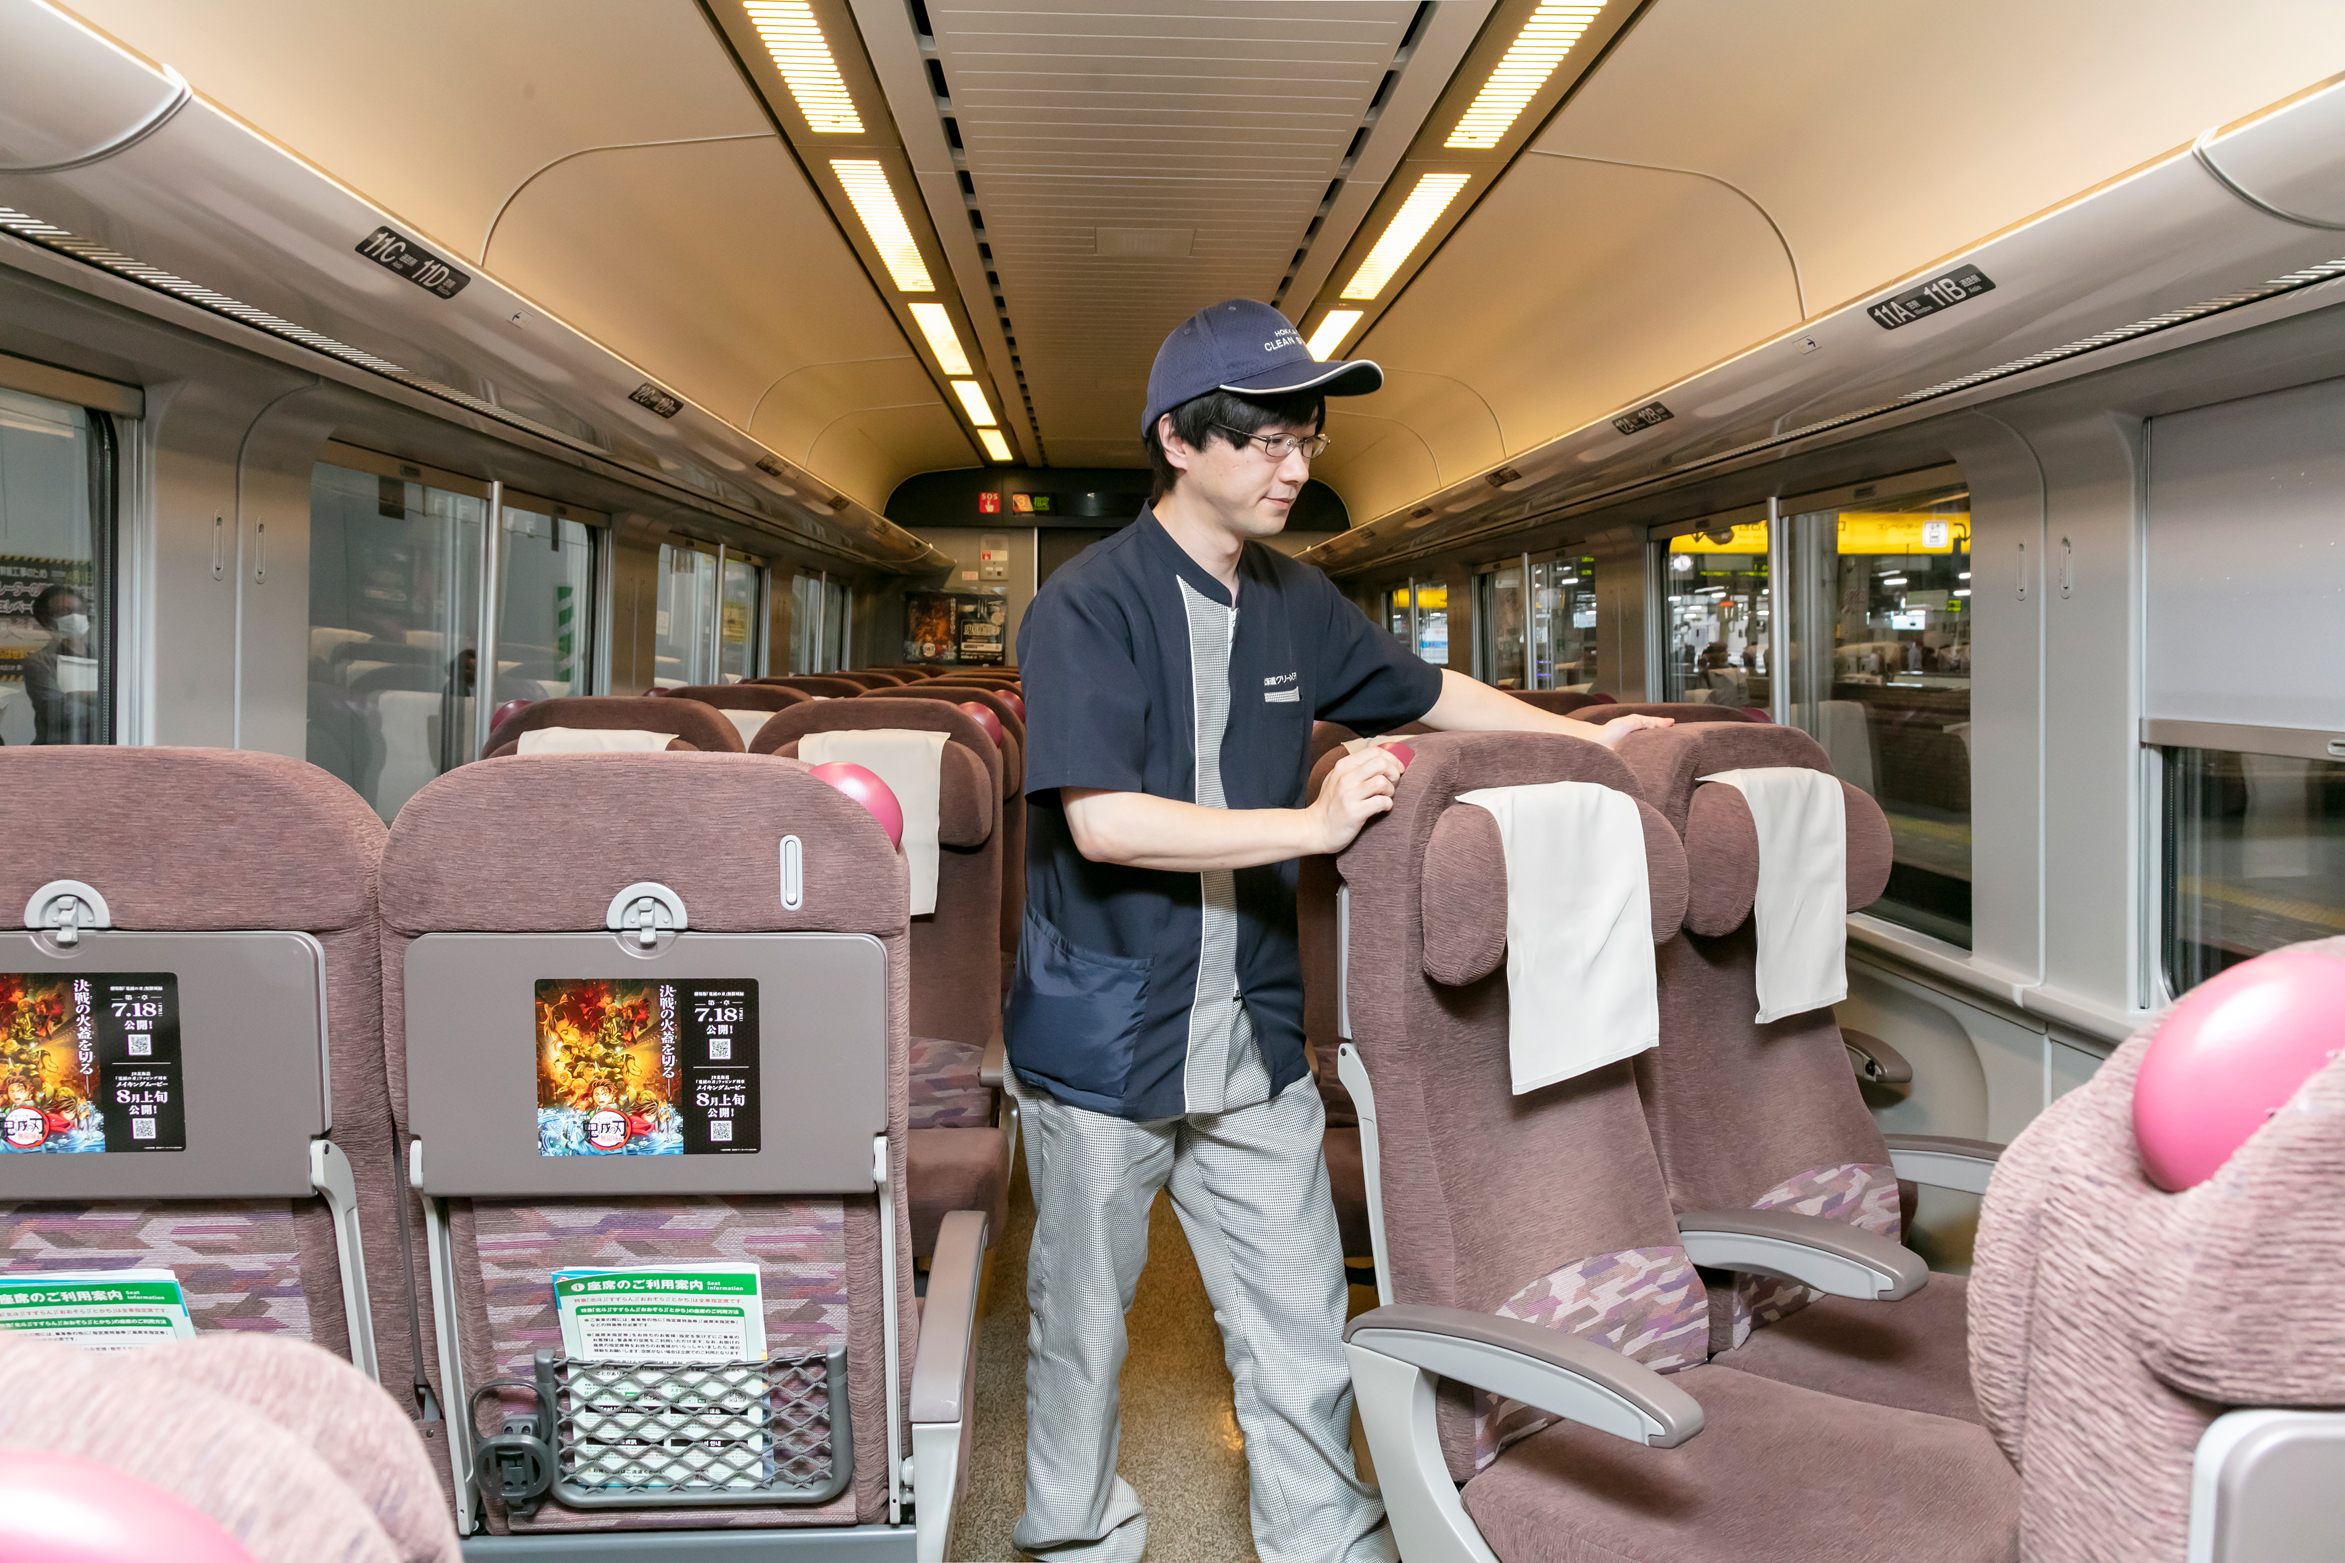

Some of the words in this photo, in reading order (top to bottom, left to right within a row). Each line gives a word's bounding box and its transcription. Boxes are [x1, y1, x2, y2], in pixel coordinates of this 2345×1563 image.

[363, 231, 406, 263] 11C
[411, 259, 450, 287] 11D
[1873, 300, 1917, 327] 11A
[1923, 278, 1967, 307] 11B
[1264, 337, 1296, 351] CLEAN
[111, 1002, 157, 1017] 7.18
[694, 1007, 738, 1022] 7.18
[116, 1089, 168, 1104] 8月上旬
[696, 1092, 745, 1107] 8月上旬
[587, 1279, 703, 1291] 座席のご利用案内
[0, 1290, 123, 1304] 座席のご利用案内
